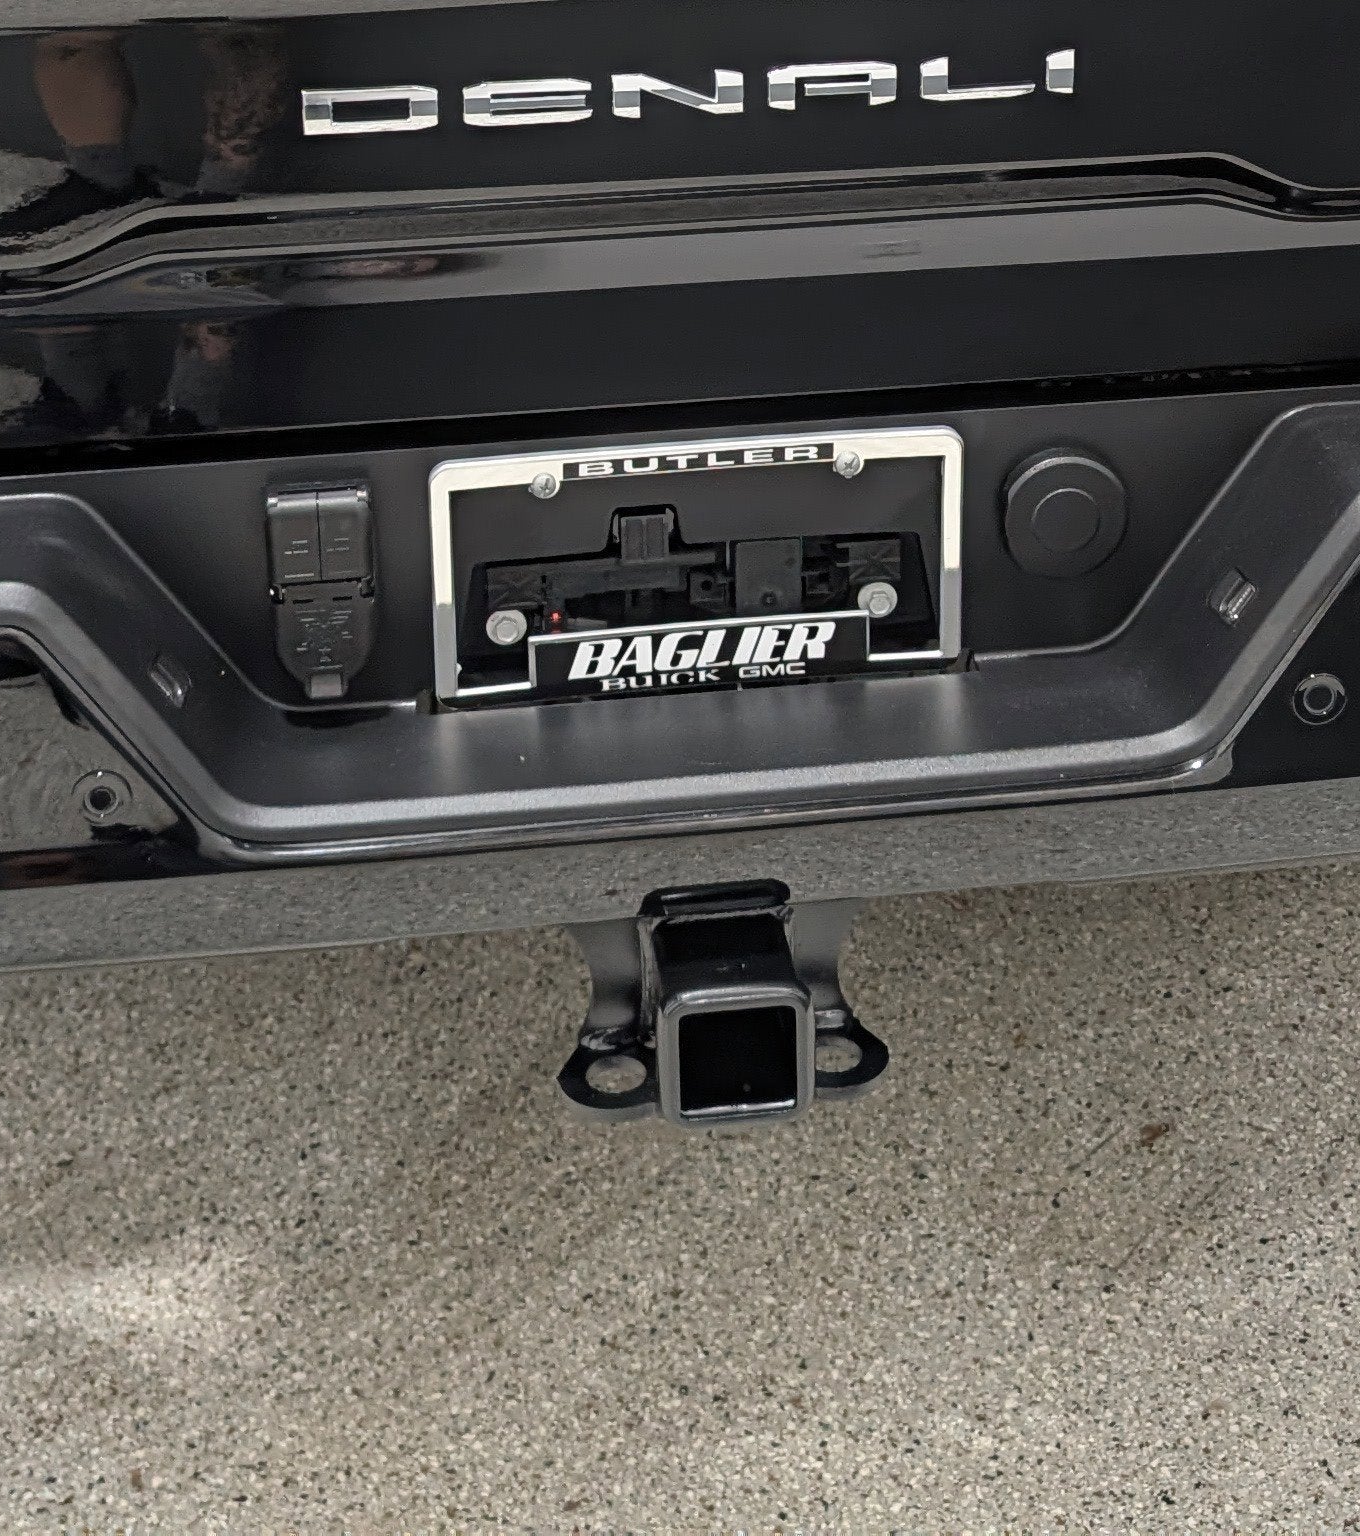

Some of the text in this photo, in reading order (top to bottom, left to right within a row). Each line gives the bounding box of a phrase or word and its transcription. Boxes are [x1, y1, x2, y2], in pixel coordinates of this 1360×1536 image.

[302, 49, 1076, 136] DENALI
[578, 446, 819, 477] BUTLER
[567, 621, 836, 681] BAGLIER
[599, 661, 806, 692] BUICK GMC
